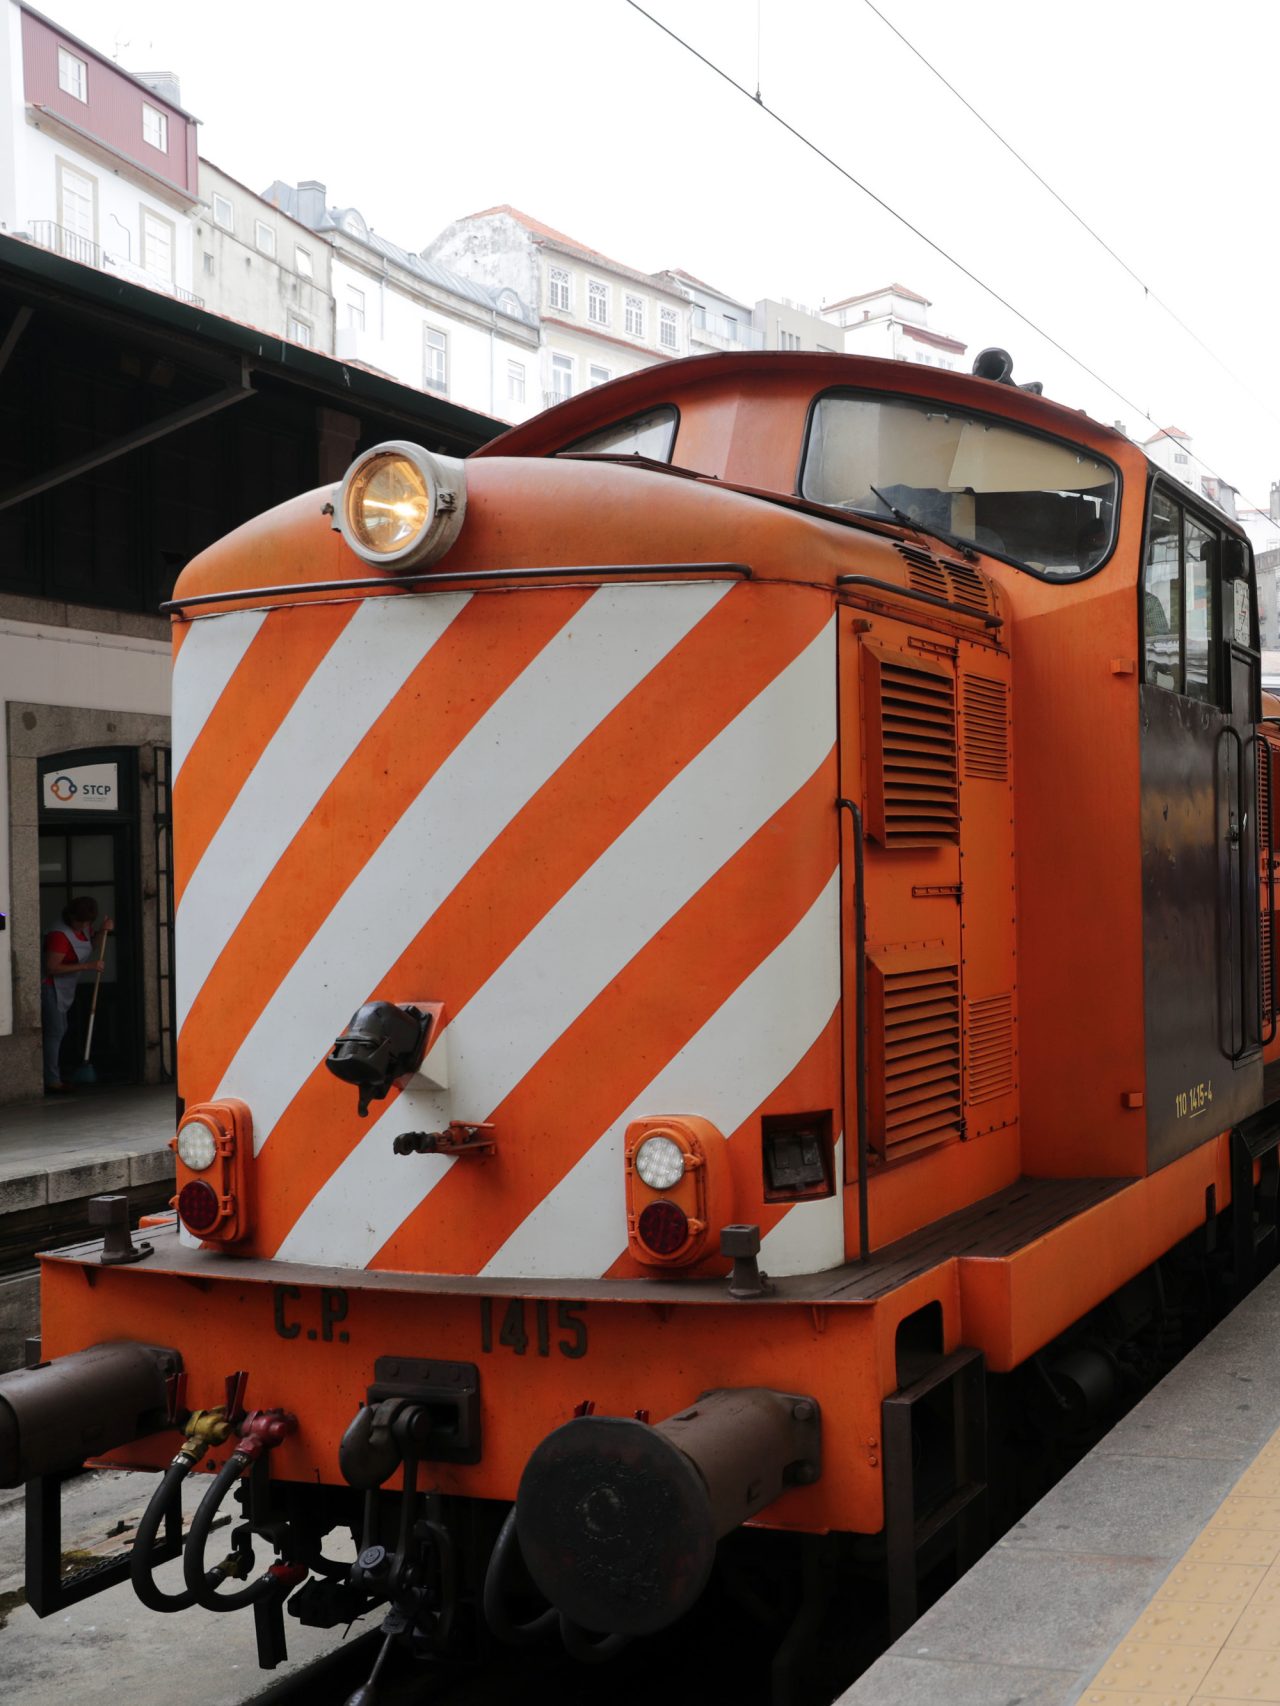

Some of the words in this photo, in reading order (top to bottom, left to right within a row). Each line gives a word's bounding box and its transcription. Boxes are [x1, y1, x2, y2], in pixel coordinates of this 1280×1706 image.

[82, 784, 111, 796] STCP
[273, 1284, 351, 1343] C.P.
[480, 1296, 588, 1359] 1415
